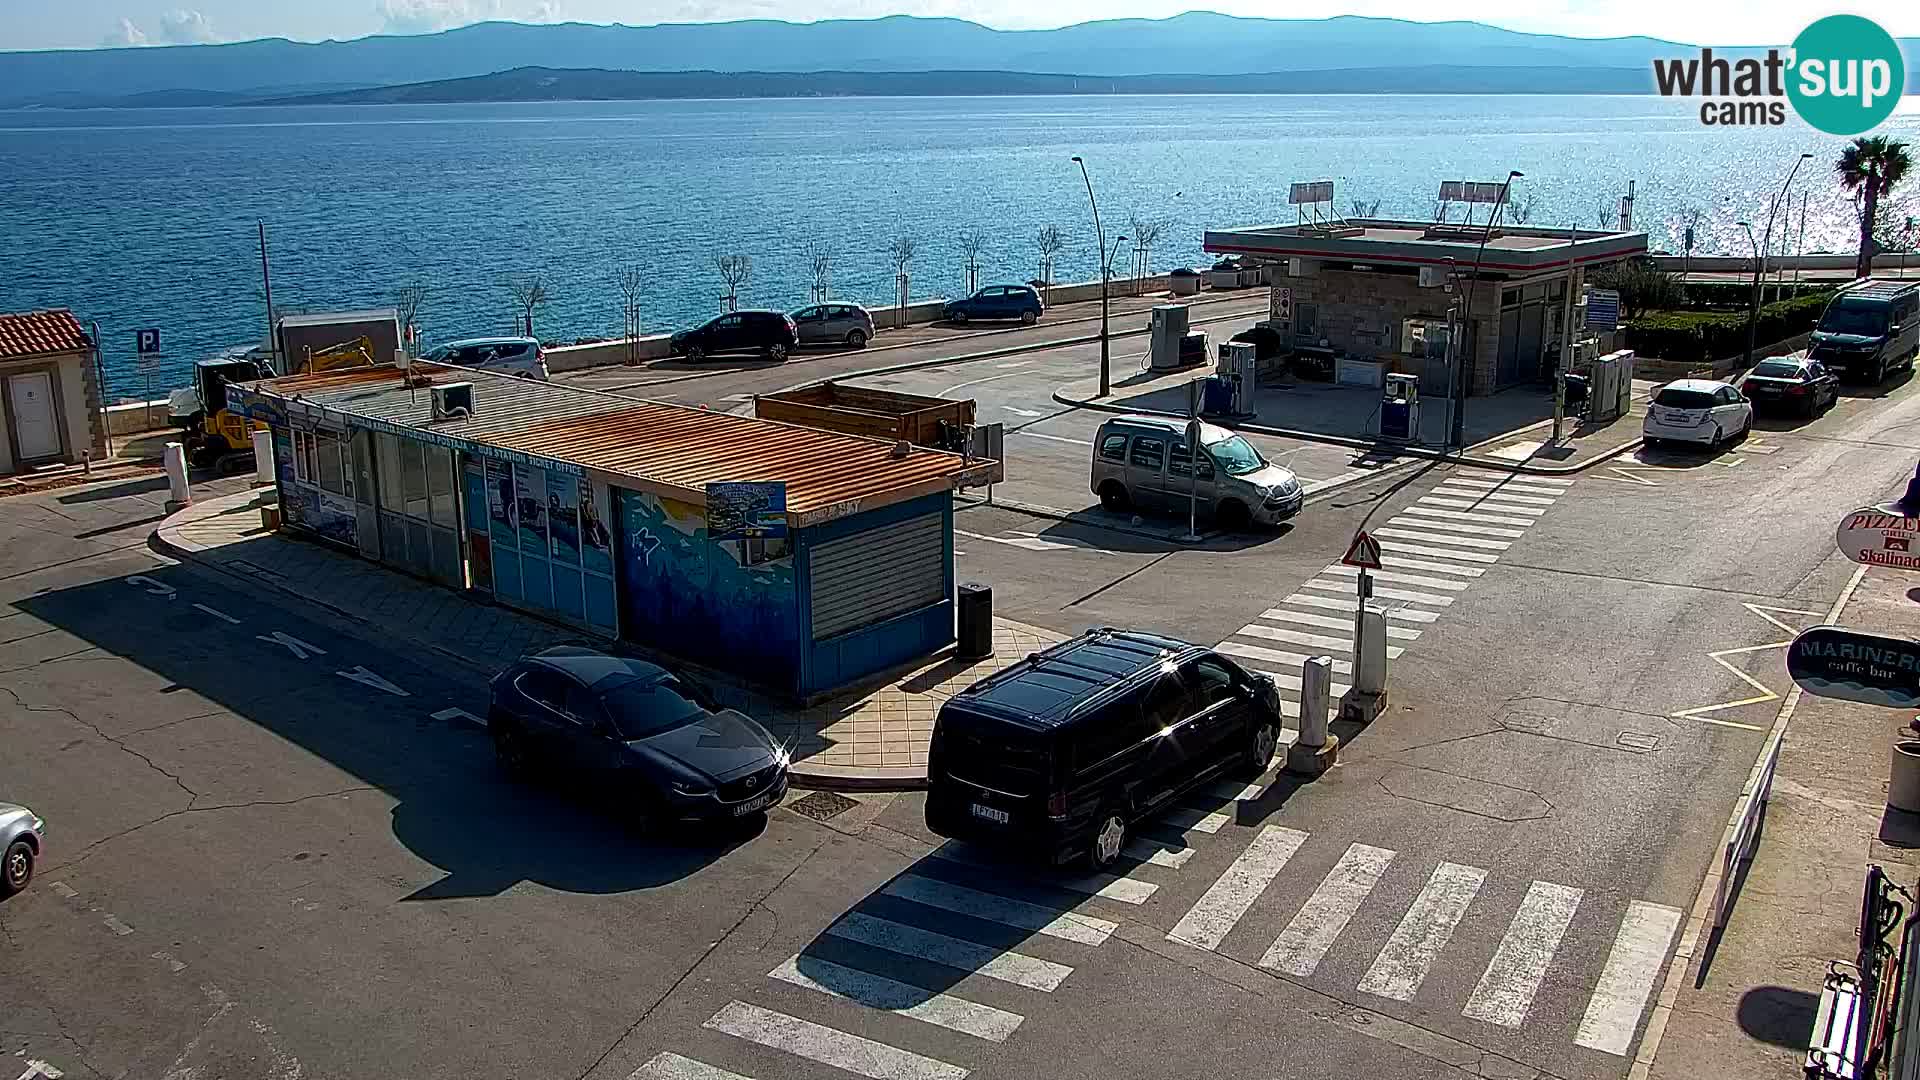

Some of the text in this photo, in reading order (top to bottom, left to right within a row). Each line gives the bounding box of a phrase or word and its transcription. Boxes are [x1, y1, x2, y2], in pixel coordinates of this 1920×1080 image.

[142, 332, 154, 350] P
[479, 446, 493, 456] BUS
[494, 450, 526, 464] STATION
[529, 457, 553, 470] TICKET
[557, 463, 583, 476] OFFICE
[1848, 514, 1920, 533] PIZZE
[1881, 529, 1916, 539] GRILL
[1828, 661, 1896, 679] caffe bar
